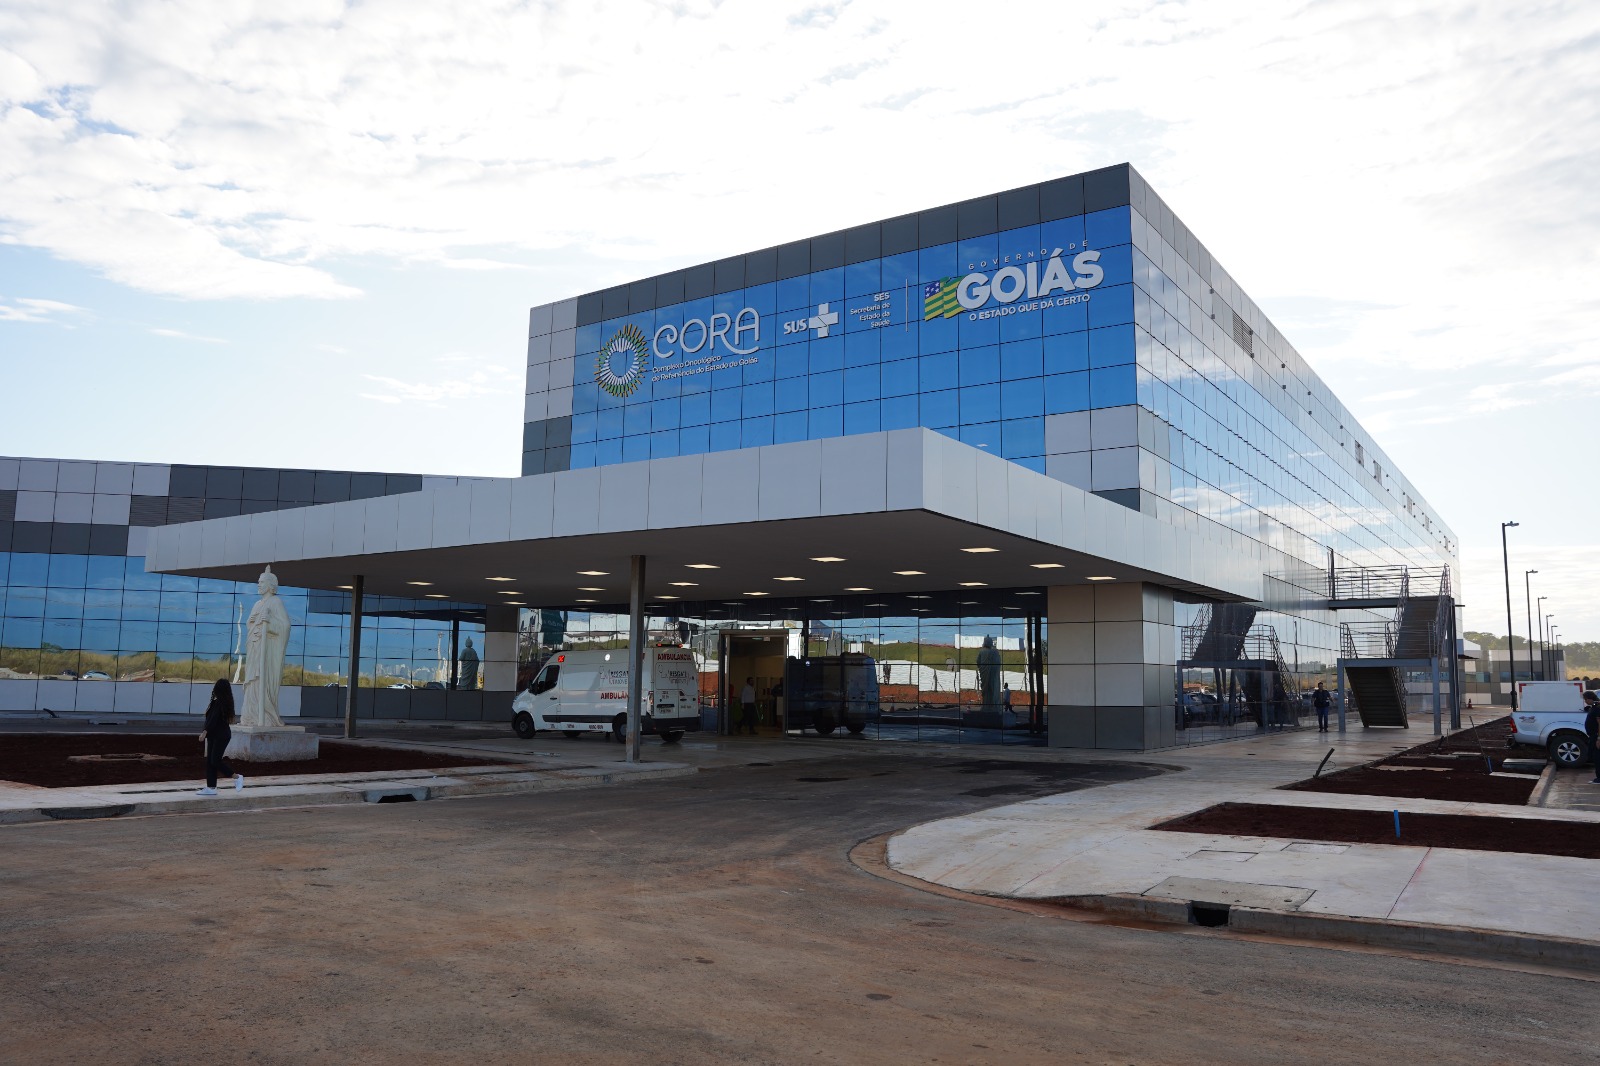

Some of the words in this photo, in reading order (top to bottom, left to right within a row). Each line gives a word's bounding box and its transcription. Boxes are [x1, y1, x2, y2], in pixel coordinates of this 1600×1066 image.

[968, 248, 1048, 270] GOVERNO
[1069, 240, 1088, 250] DE
[956, 247, 1105, 310] GOIÁS
[873, 292, 890, 302] SES
[850, 304, 880, 315] Secretaria
[969, 313, 977, 321] O
[979, 305, 1016, 320] ESTADO
[1018, 302, 1039, 313] QUE
[1041, 299, 1054, 309] DÁ
[1056, 293, 1091, 306] CERTO
[859, 313, 881, 321] Estado
[870, 319, 891, 328] Saúde
[653, 307, 760, 359] CORA
[783, 319, 808, 335] SUS
[652, 362, 684, 373] Complexo
[684, 355, 722, 367] Oncológico
[660, 369, 696, 380] Referência
[705, 362, 729, 372] Estado
[739, 357, 759, 366] Goiás
